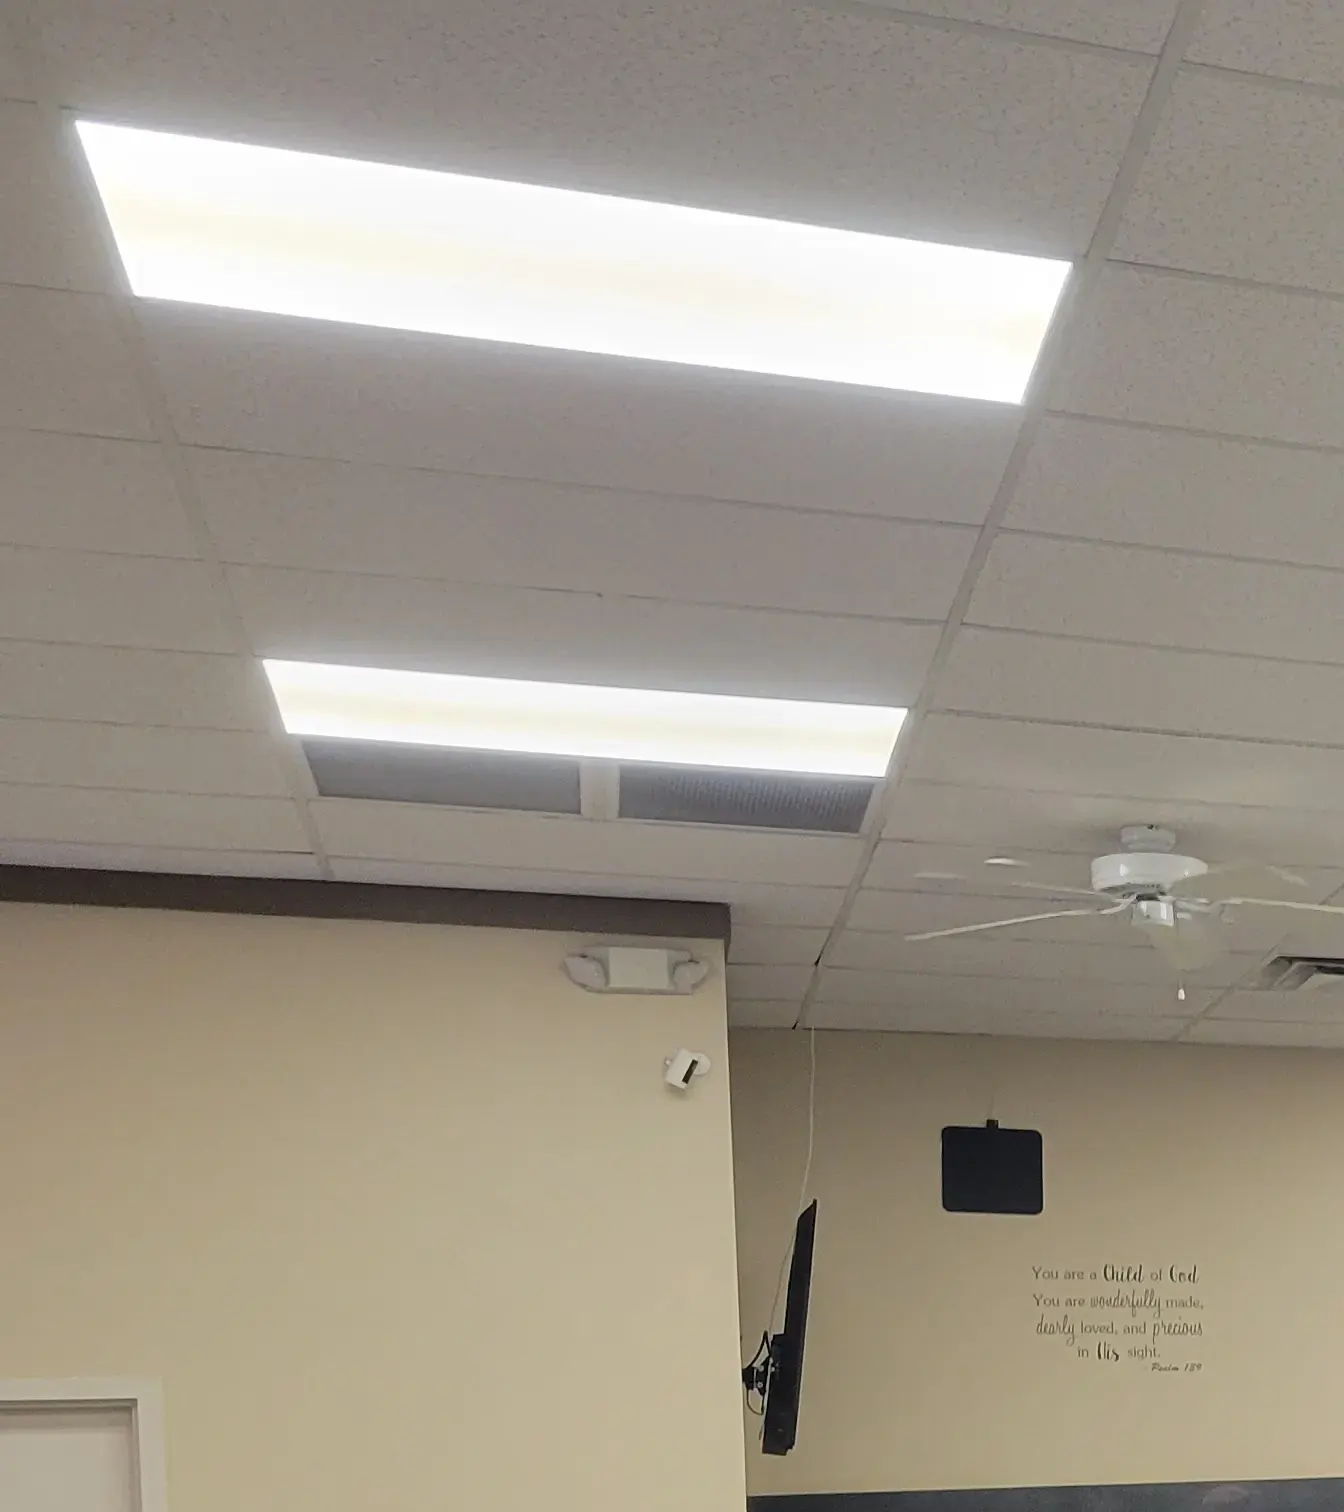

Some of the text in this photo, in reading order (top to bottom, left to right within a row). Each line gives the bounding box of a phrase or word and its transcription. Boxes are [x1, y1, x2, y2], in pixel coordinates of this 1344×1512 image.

[1032, 1264, 1199, 1284] You are a Child of God
[1032, 1288, 1204, 1319] You are wonderfully made,
[1036, 1313, 1203, 1347] dearly loved, and precious
[1077, 1342, 1160, 1362] in His sight.
[1151, 1362, 1179, 1372] Psalm
